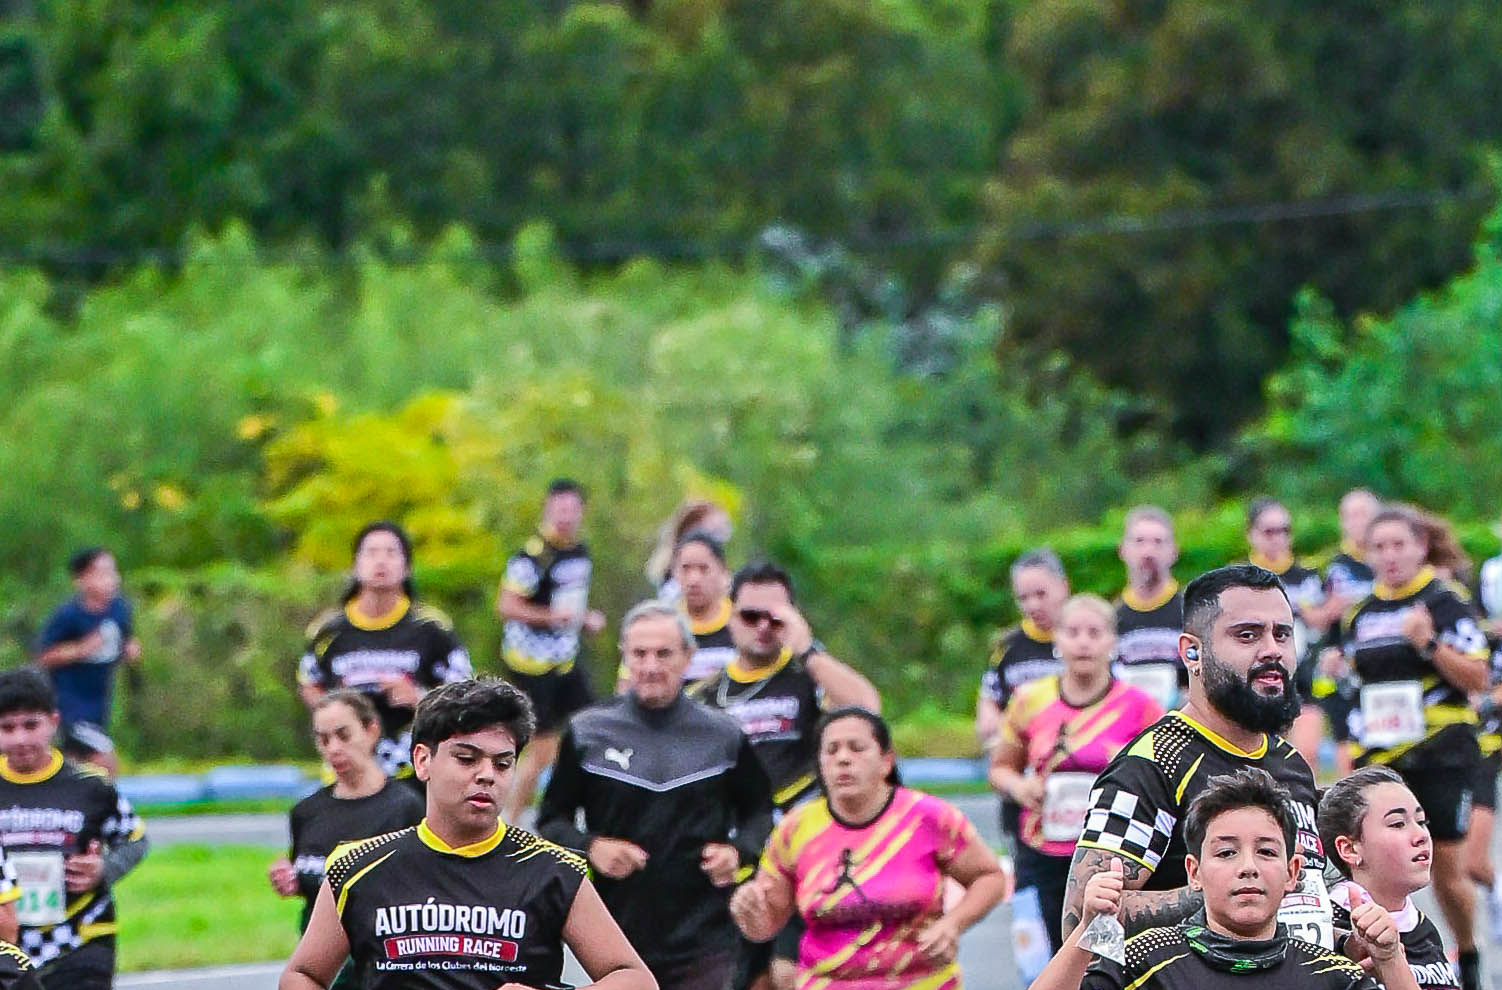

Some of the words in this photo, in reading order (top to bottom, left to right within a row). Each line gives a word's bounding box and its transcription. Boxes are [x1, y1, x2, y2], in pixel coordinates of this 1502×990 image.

[375, 896, 527, 939] AUTÓDROMO
[396, 936, 460, 956] RUNNING
[463, 937, 503, 958] RACE
[376, 960, 386, 970] La
[415, 961, 426, 970] de
[428, 961, 440, 970] los
